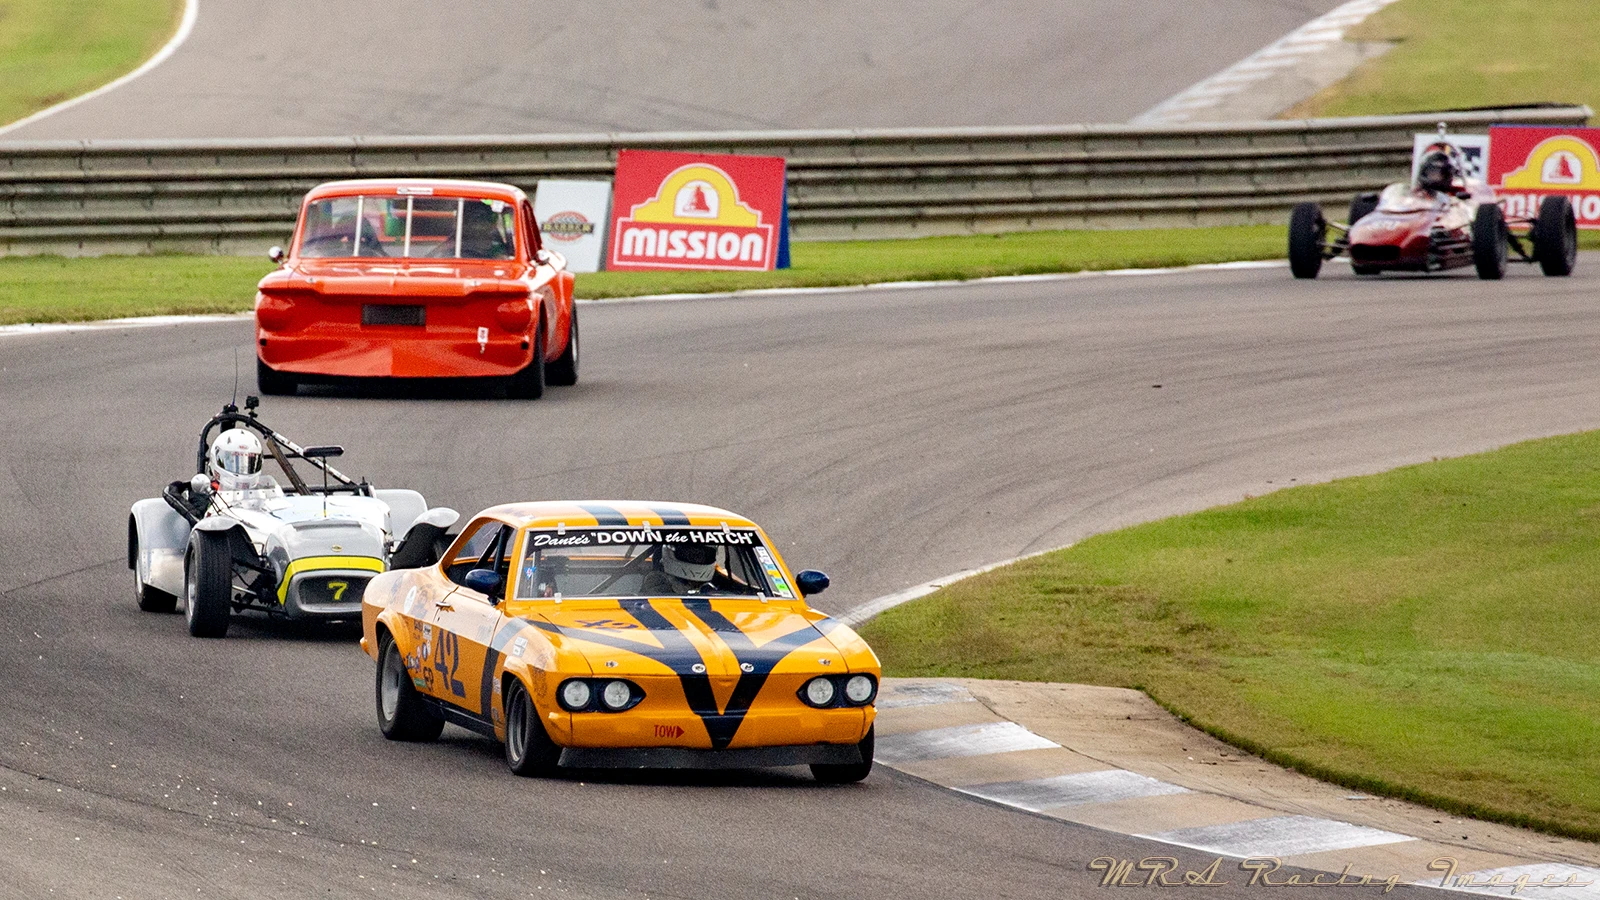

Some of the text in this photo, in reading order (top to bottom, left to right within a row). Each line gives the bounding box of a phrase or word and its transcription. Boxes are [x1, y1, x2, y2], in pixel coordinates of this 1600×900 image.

[1498, 194, 1600, 220] MIIO
[621, 227, 764, 262] MISSION
[665, 531, 688, 543] the
[328, 581, 348, 600] 7
[435, 628, 466, 699] 42
[654, 724, 677, 738] TOW
